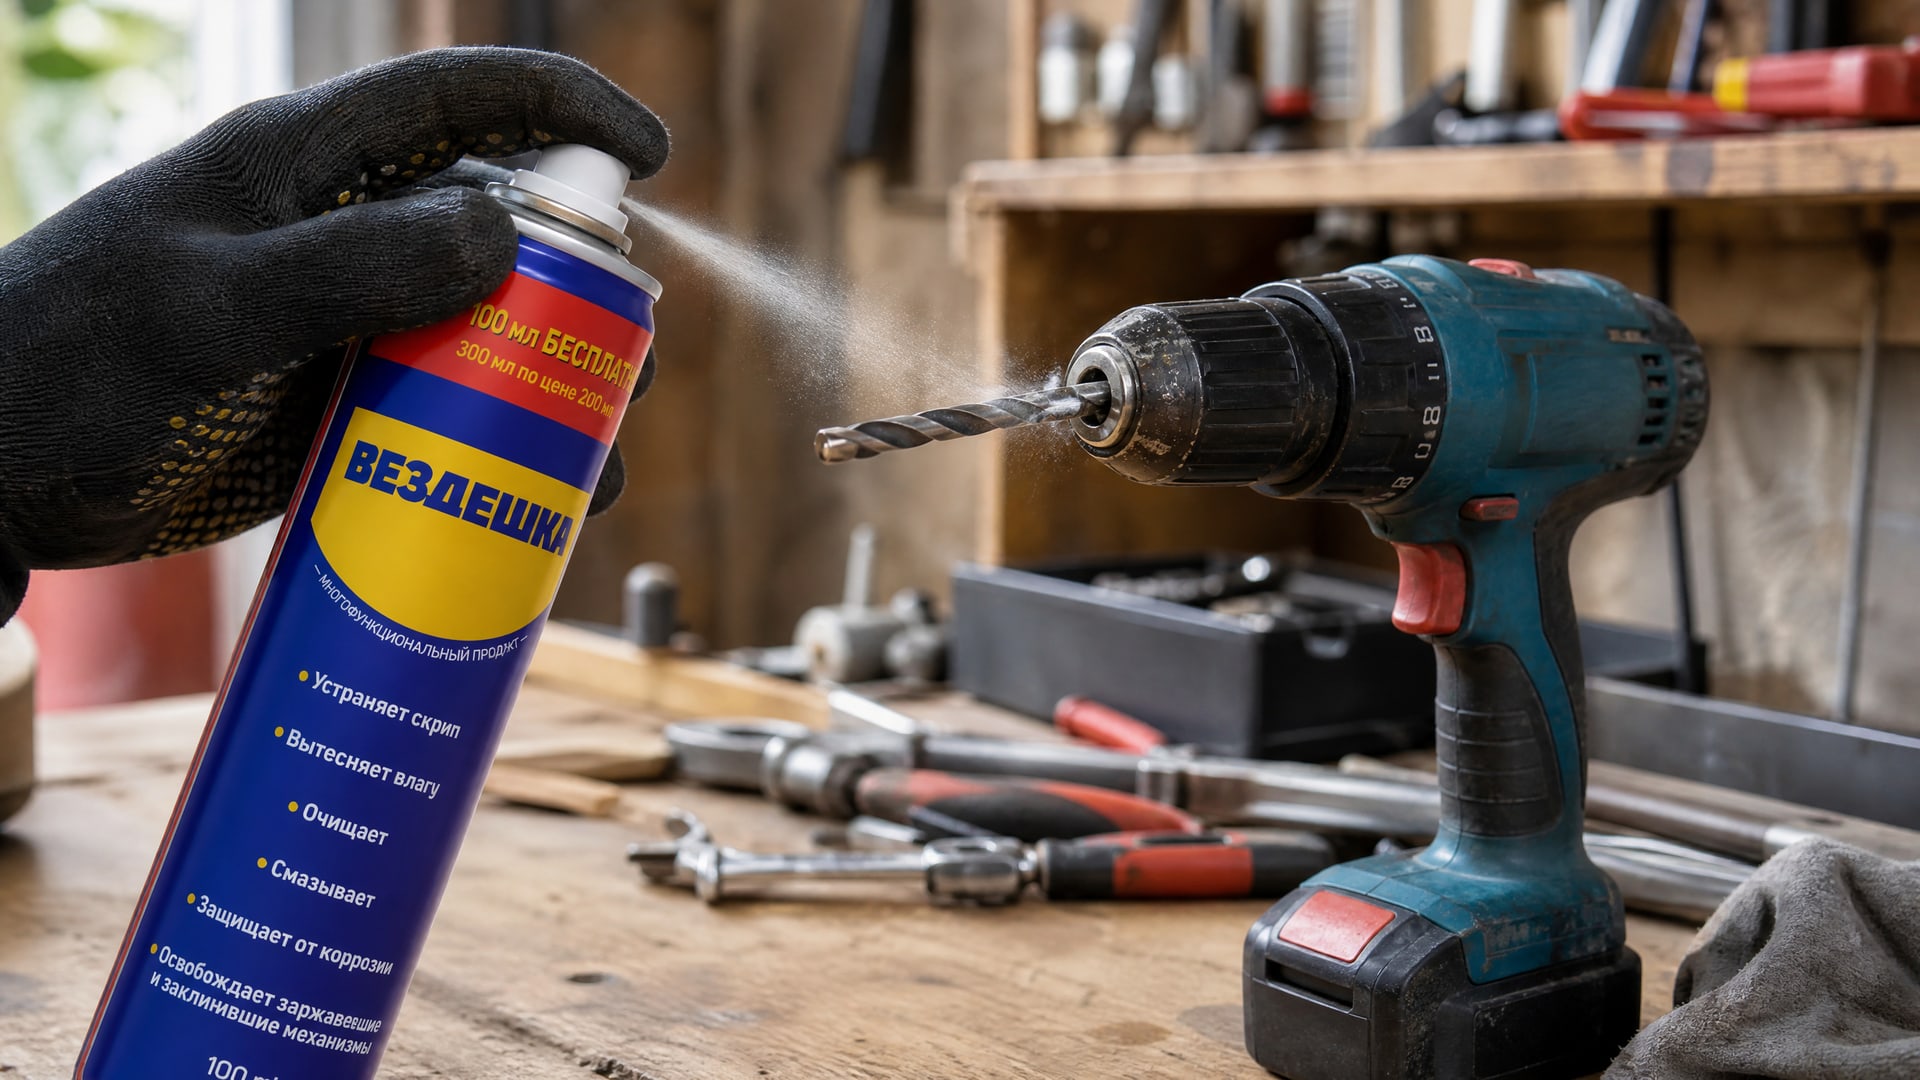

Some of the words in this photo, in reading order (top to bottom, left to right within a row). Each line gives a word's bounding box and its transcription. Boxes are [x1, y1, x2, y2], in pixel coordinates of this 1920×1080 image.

[456, 340, 491, 365] 300
[490, 356, 517, 375] мл
[516, 366, 540, 384] по
[540, 375, 578, 401] цене
[577, 388, 602, 412] 200
[469, 302, 510, 336] 100
[507, 320, 541, 348] мл
[541, 328, 639, 394] БЕСПЛАТН
[344, 440, 574, 557] ВЕЗДЕШКА
[318, 574, 470, 662] МНОГОФУНКЦИОНАЛЬНЫЙ
[312, 671, 410, 722] Устраняет
[411, 712, 461, 738] скрип
[285, 728, 392, 782] Вытесняет
[393, 771, 441, 800] влагу
[302, 802, 389, 846] Очищает
[271, 859, 376, 909] Смазывает
[196, 894, 293, 948] Защищает
[294, 938, 318, 956] от
[319, 945, 394, 975] коррозии
[158, 945, 276, 1007] Освобождает
[150, 971, 161, 987] и
[161, 977, 280, 1034] заклинившие
[282, 1024, 373, 1055] механизмы
[207, 1056, 248, 1080] 100
